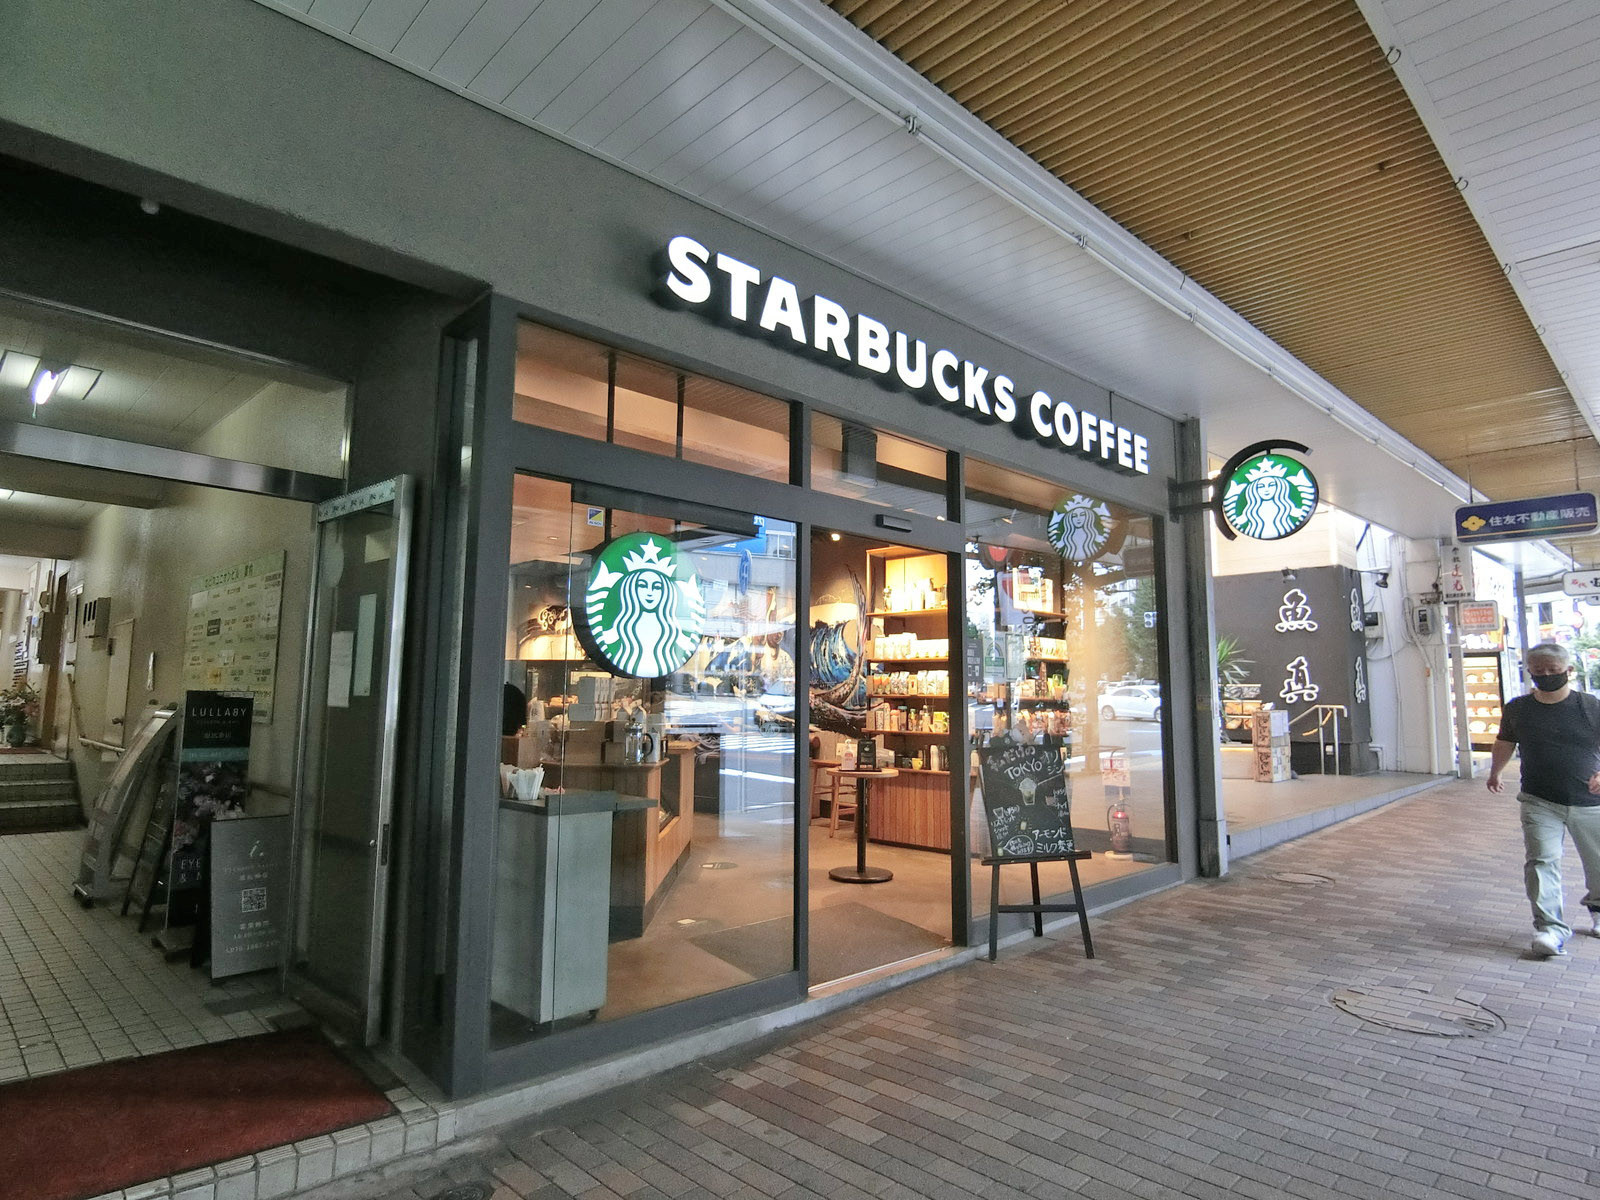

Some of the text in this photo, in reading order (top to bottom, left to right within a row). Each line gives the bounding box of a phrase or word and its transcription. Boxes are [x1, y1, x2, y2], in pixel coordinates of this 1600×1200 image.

[666, 236, 1150, 475] STARBUCKS COFFEE
[1488, 507, 1590, 527] 住友不動産販売
[192, 707, 247, 717] LULLABY
[1004, 758, 1043, 780] TOKYO
[1031, 827, 1066, 841] アーモンド
[1036, 840, 1075, 853] ミルク変更
